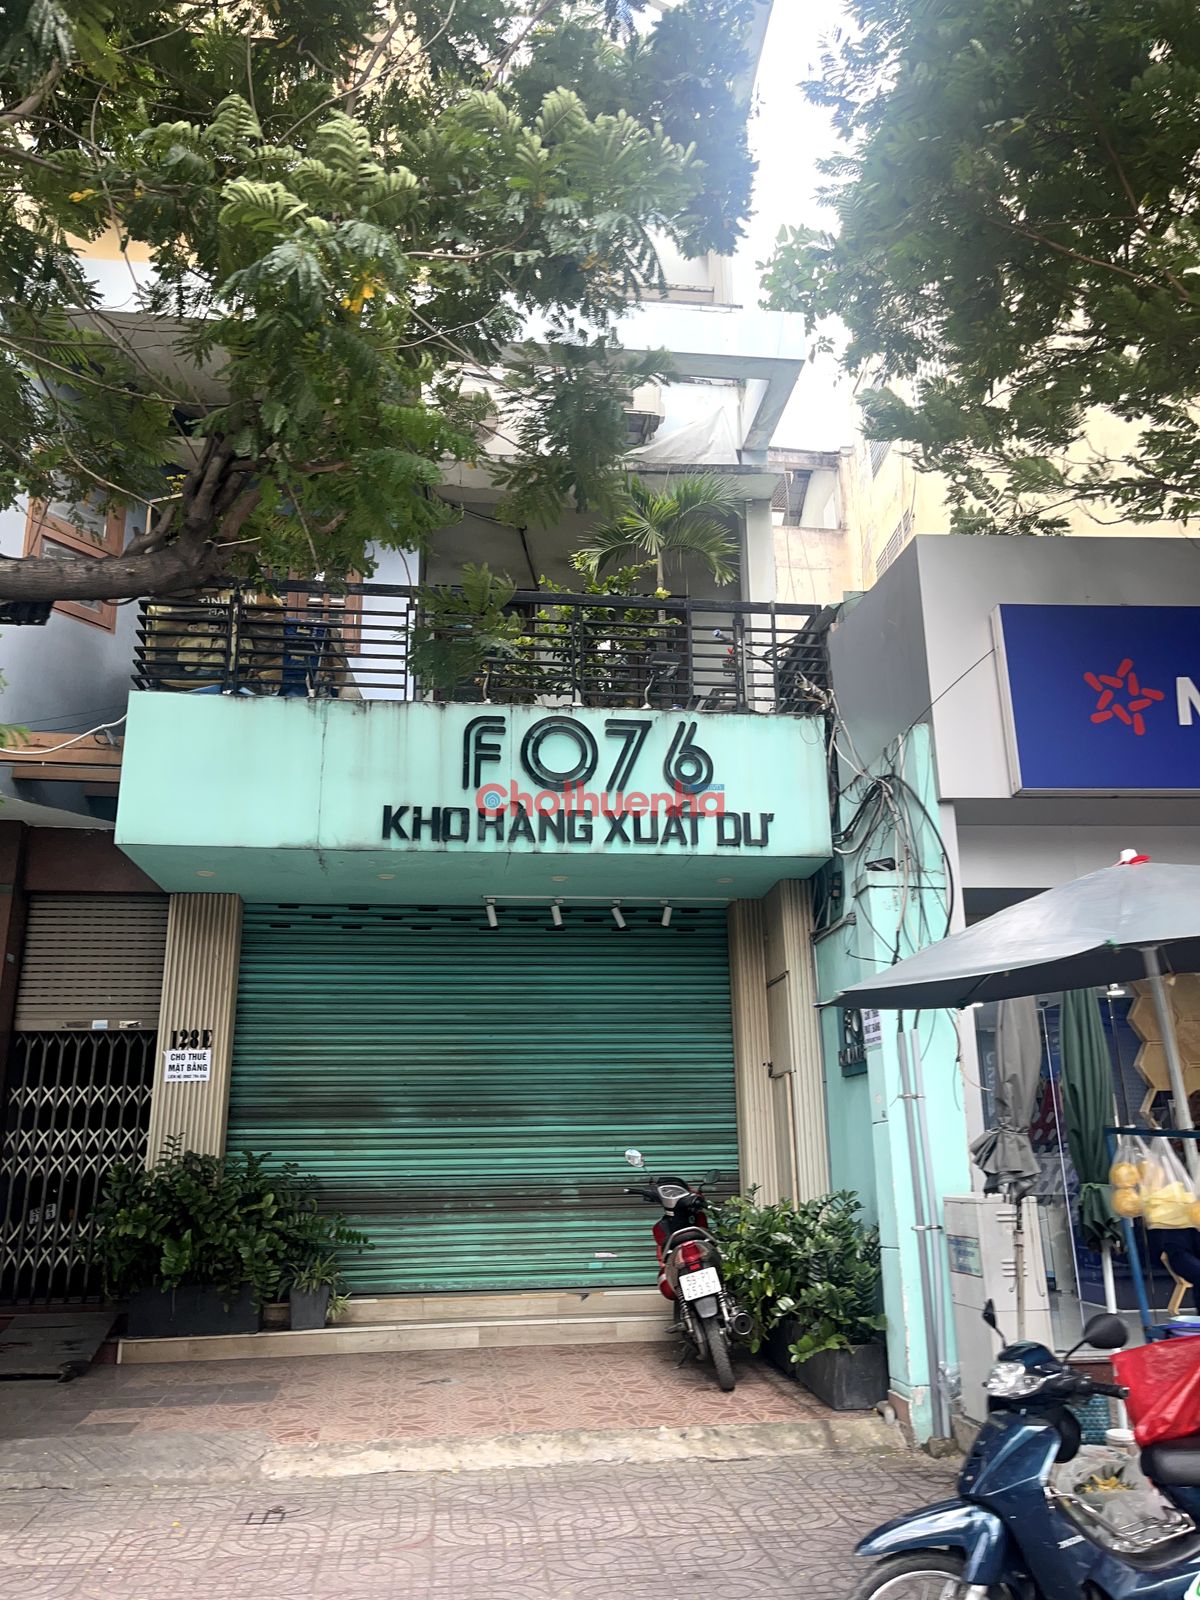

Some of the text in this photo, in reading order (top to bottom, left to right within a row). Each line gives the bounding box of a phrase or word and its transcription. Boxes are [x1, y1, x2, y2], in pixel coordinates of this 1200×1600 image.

[382, 805, 470, 843] KHO
[717, 811, 775, 847] DƯ
[171, 1029, 213, 1050] 128E
[170, 1052, 207, 1061] CHO THUÊ
[168, 1063, 185, 1073] MẶT
